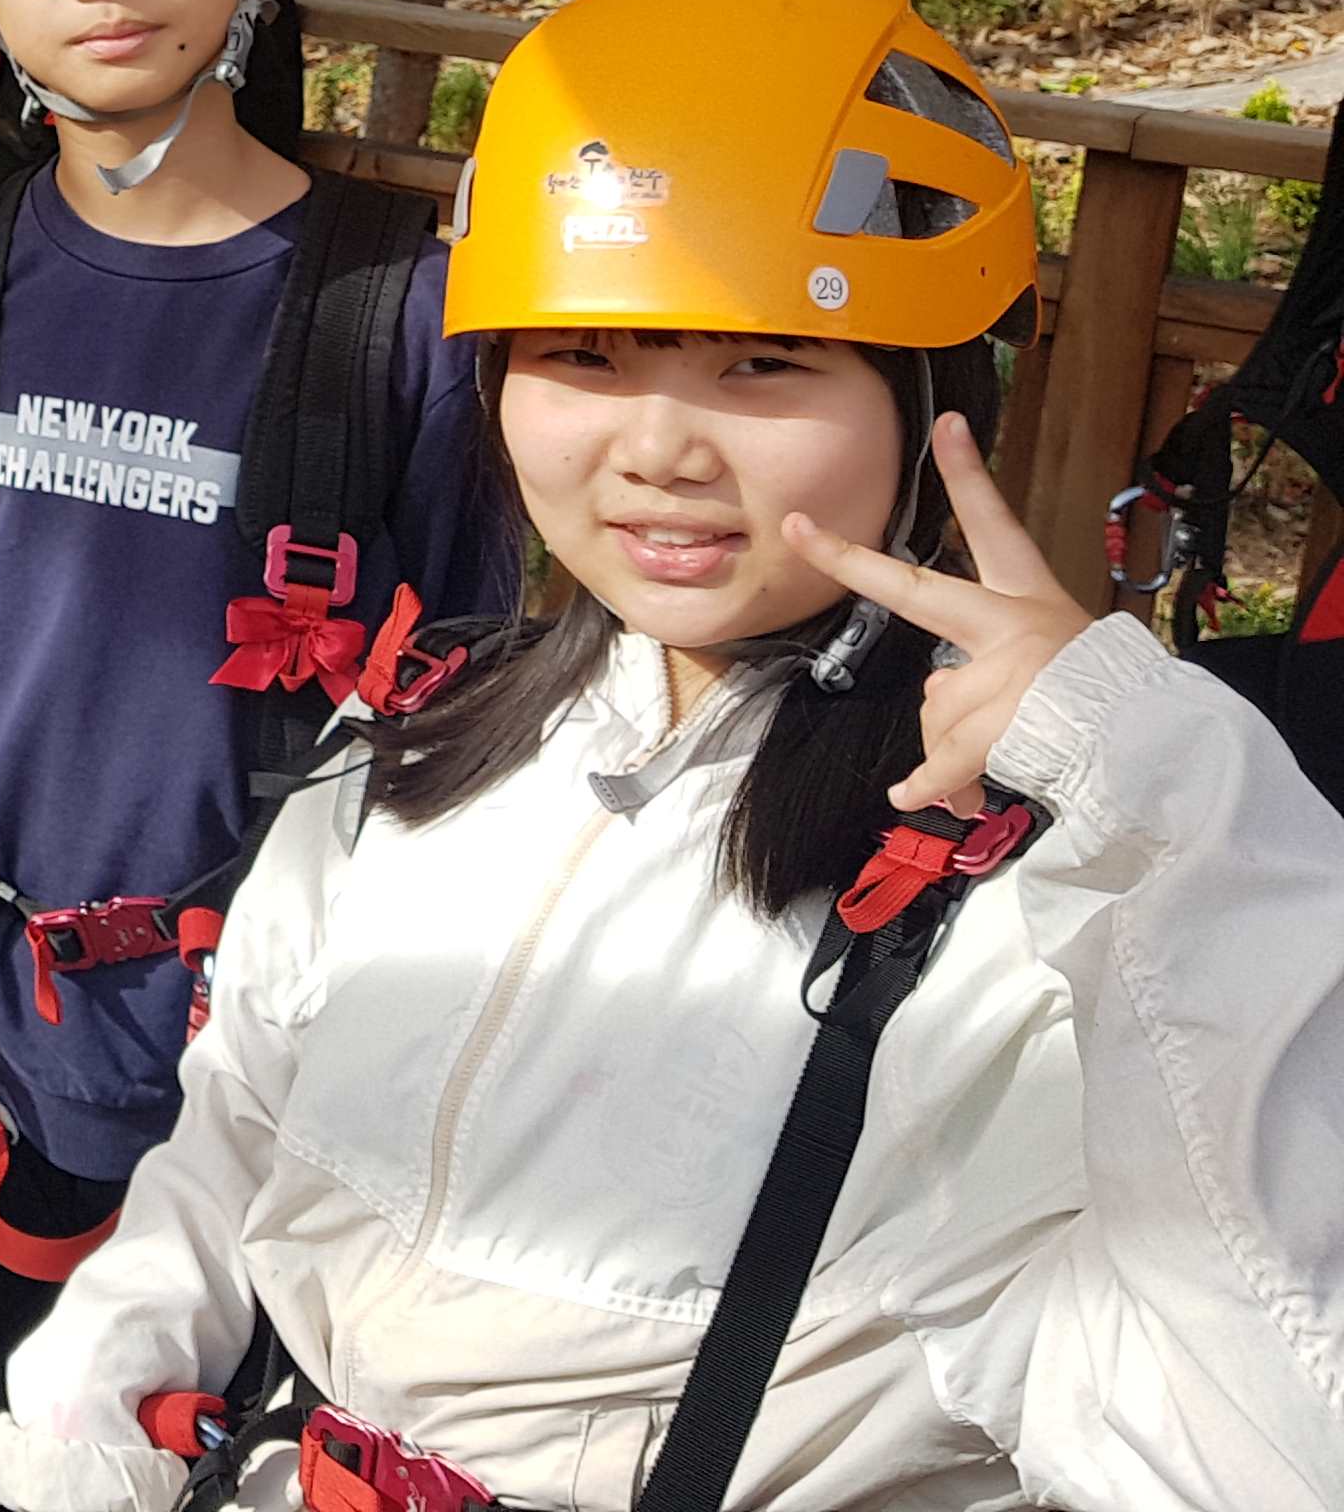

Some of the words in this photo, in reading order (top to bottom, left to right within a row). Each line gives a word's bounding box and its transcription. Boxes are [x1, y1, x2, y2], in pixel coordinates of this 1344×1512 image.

[815, 276, 843, 300] 29
[16, 393, 96, 444] NEW
[100, 405, 199, 463] YORK
